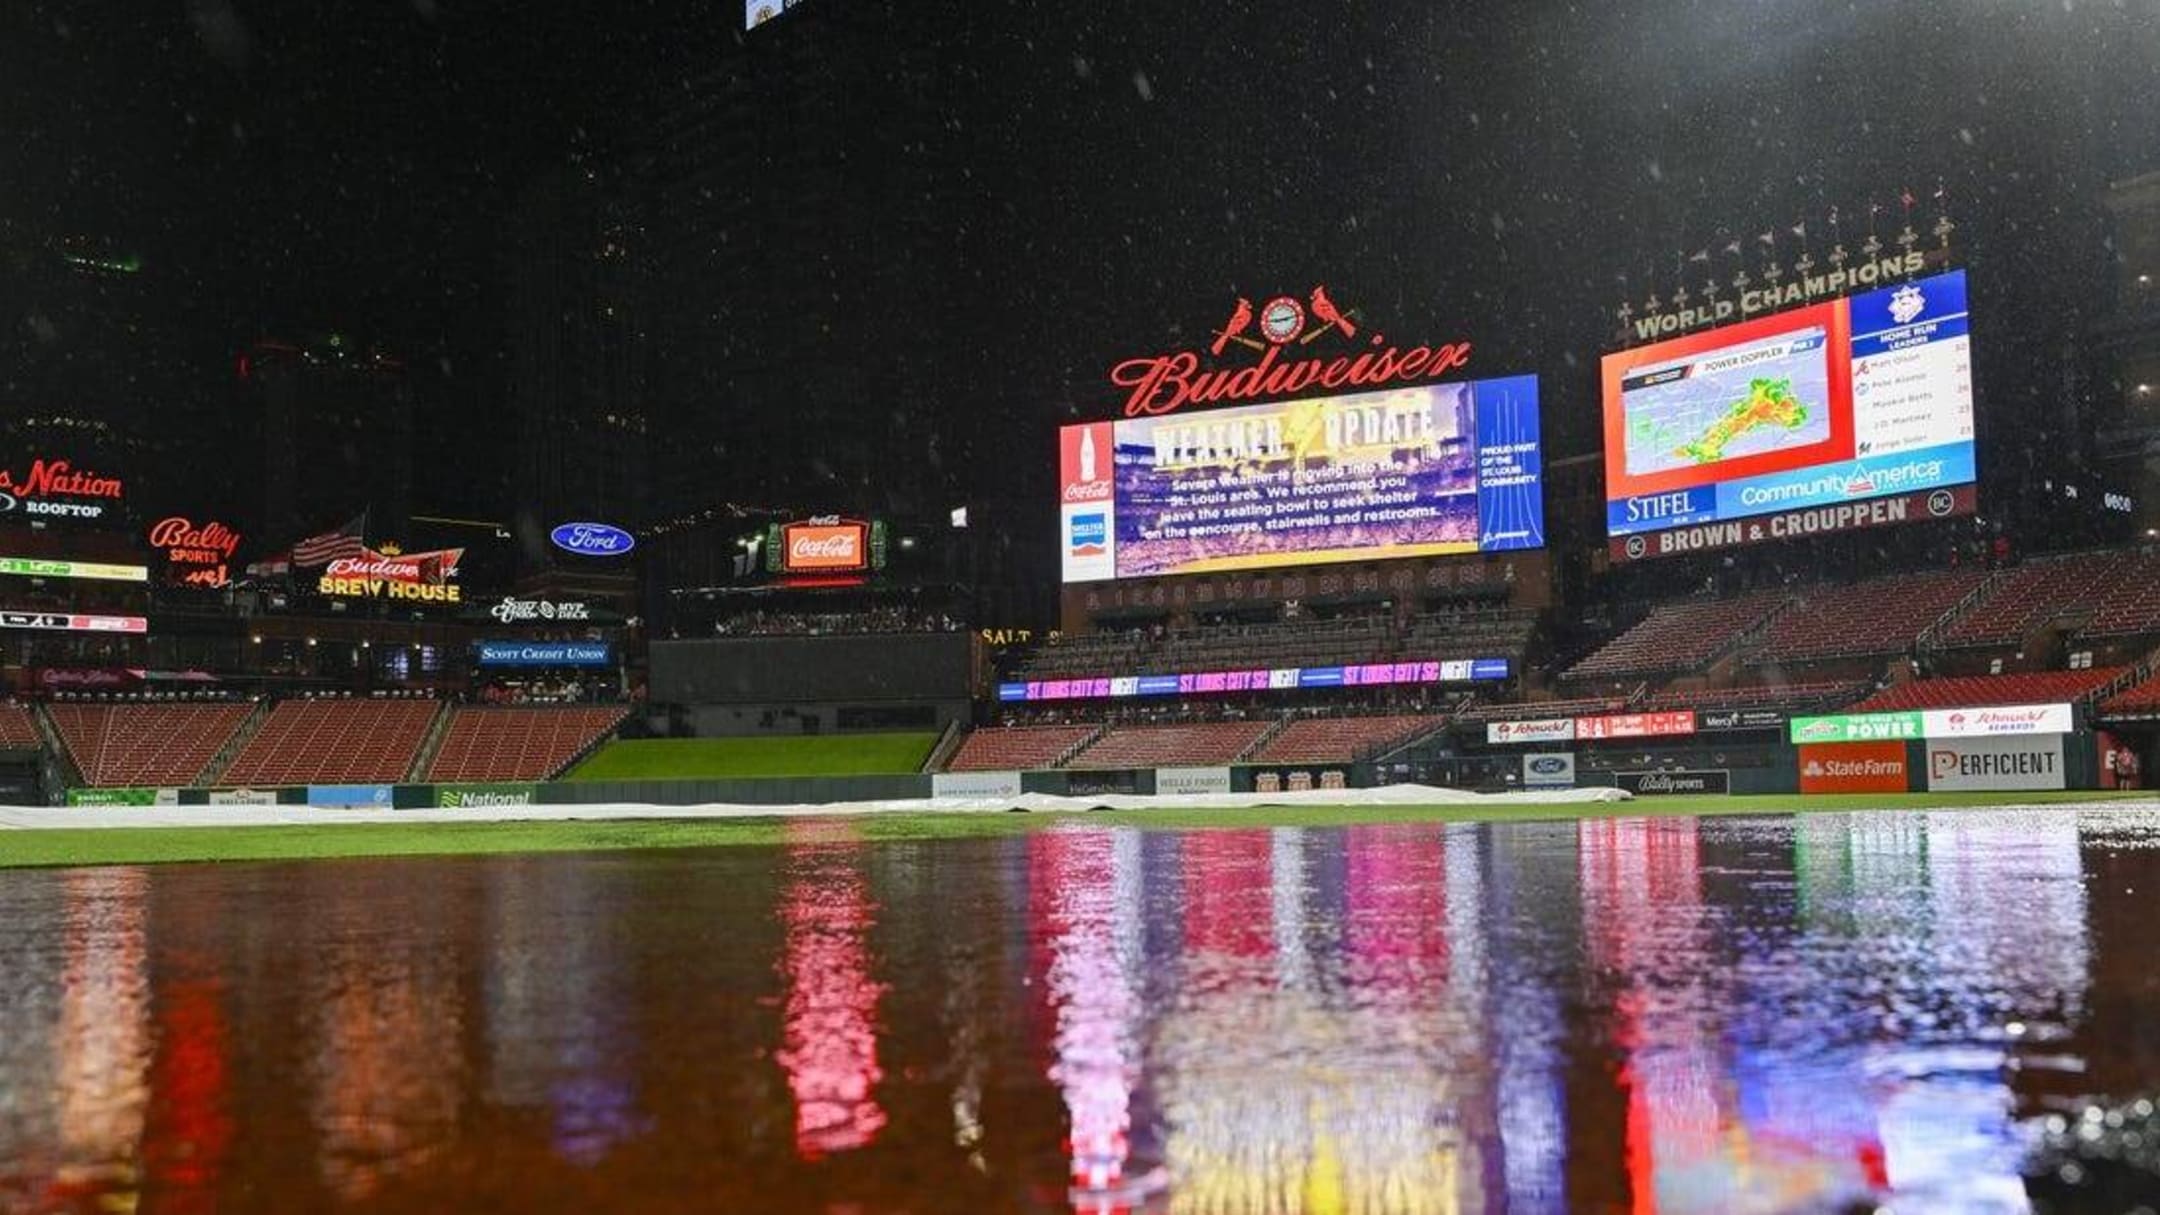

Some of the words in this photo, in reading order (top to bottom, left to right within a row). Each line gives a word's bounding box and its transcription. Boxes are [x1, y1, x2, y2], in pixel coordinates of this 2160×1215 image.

[1636, 301, 1733, 340] WORLD
[1740, 252, 1925, 314] CHAMPIONS
[1111, 335, 1471, 418] Budweiser
[1154, 417, 1283, 467] WEATHER
[1324, 402, 1432, 450] UPDATE
[13, 459, 121, 498] Nation
[1380, 460, 1403, 472] the
[1192, 491, 1226, 504] Louis
[1267, 486, 1289, 499] We
[1293, 478, 1377, 496] recommend
[1380, 477, 1406, 490] you
[26, 501, 102, 517] ROOFTOP
[1160, 510, 1195, 524] leave
[1198, 507, 1219, 519] the
[1224, 503, 1272, 517] seating
[1277, 499, 1309, 513] bowl
[1314, 499, 1328, 510] to
[1333, 495, 1365, 507] seek
[1370, 491, 1417, 506] shelter
[1627, 492, 1695, 522] STIFEL
[1165, 526, 1186, 538] the
[1266, 513, 1330, 530] stairwells
[1334, 511, 1360, 525] and
[1660, 524, 1742, 553] BROWN
[1750, 525, 1764, 540] &
[1771, 499, 1906, 537] CROUPPEN
[150, 517, 240, 558] Bally
[569, 526, 618, 550] Ford
[793, 534, 855, 558] Coca-Cola
[170, 549, 218, 563] SPORTS
[319, 577, 383, 597] BREW
[388, 581, 461, 601] HOUSE
[982, 628, 1031, 646] SALT
[482, 648, 519, 659] SCOTT
[521, 647, 564, 660] CREDIT
[567, 647, 606, 660] UNION
[1847, 722, 1916, 737] POWER
[1932, 751, 2056, 779] PERFICIENT
[1638, 775, 1674, 792] Bally
[460, 790, 530, 808] National
